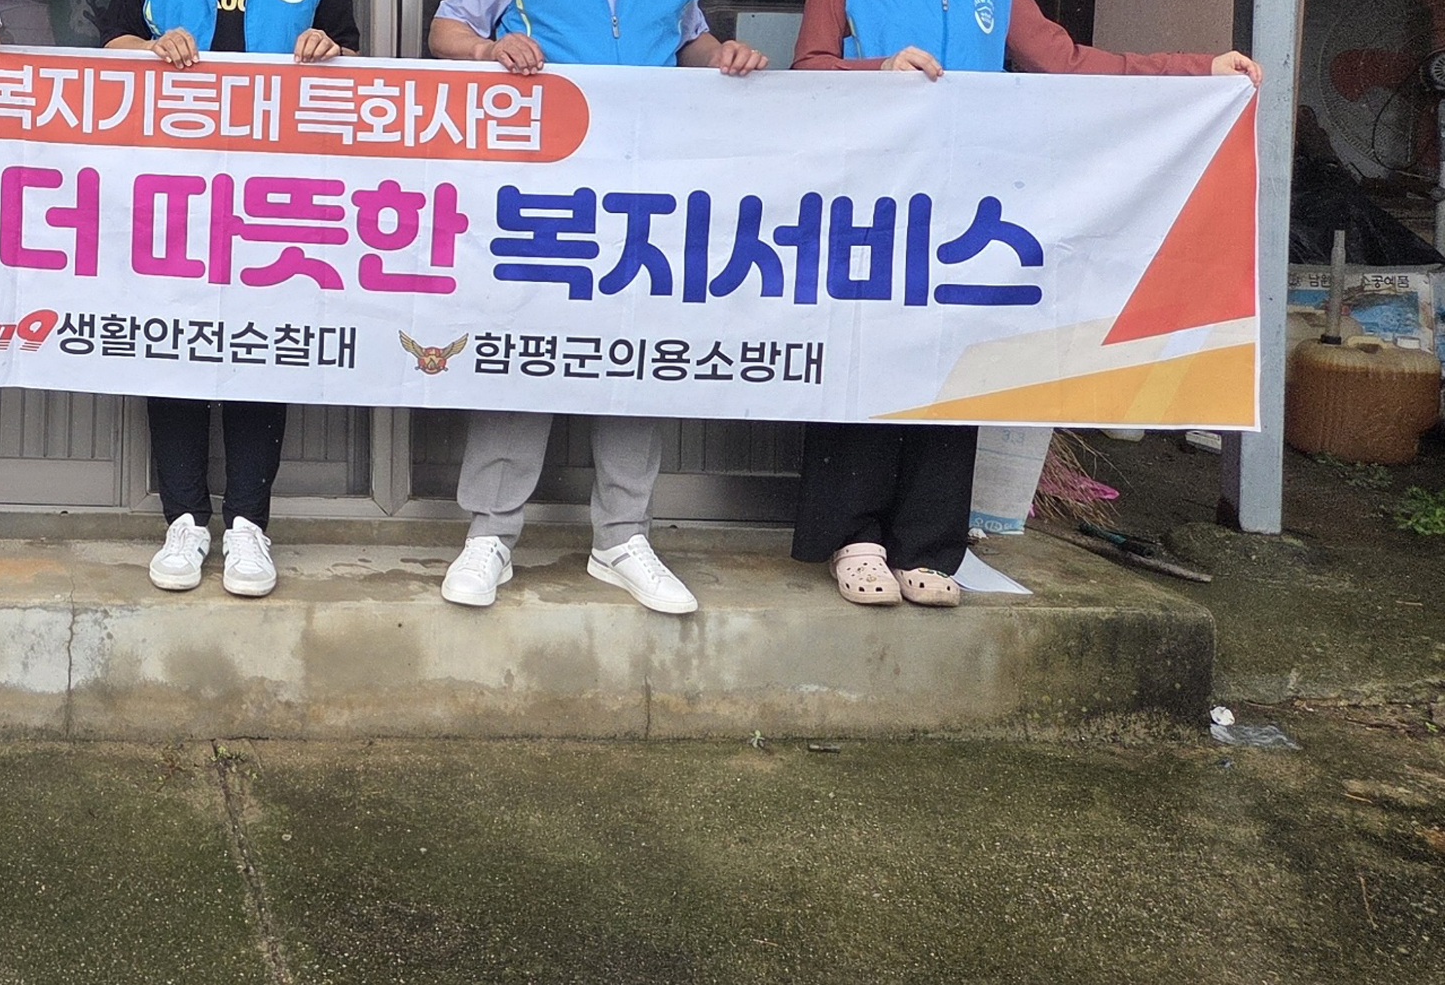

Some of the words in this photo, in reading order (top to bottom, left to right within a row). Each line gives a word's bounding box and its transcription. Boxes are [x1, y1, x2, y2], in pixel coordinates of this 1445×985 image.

[295, 75, 544, 151] 특화사업
[0, 166, 100, 276] 더
[132, 174, 469, 294] 따뜻한
[490, 185, 1044, 306] 복지서비스
[57, 313, 356, 369] 생활안전순찰대
[474, 332, 824, 385] 함평군의용소방대
